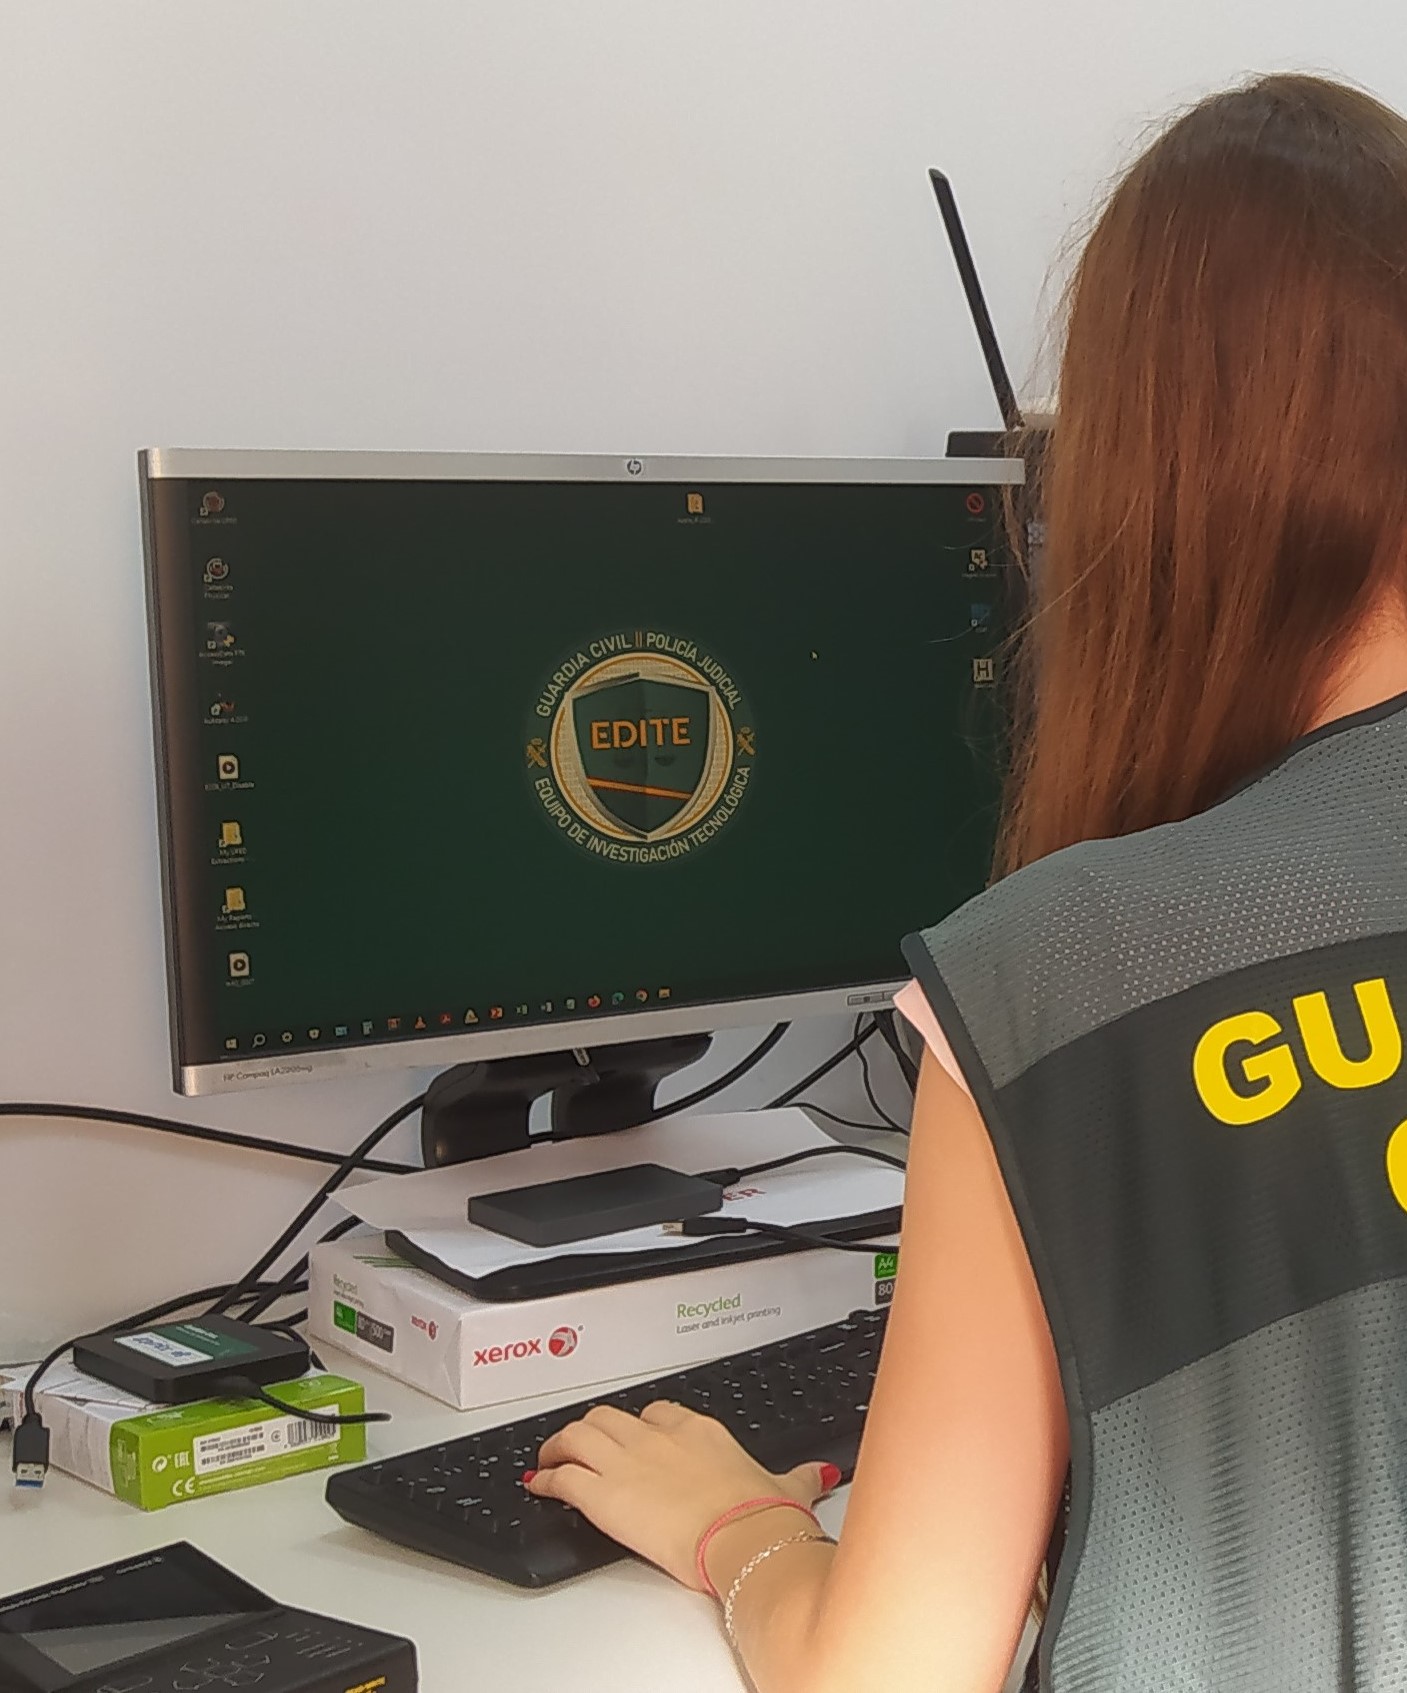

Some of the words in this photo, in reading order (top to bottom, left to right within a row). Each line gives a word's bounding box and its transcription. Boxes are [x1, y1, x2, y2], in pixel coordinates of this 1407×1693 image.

[536, 652, 590, 717] GUARDIA
[589, 633, 632, 658] CIVIL
[646, 632, 698, 662] POLICÍA
[697, 654, 743, 710] JUDICIAL
[591, 717, 691, 750] EDITE
[535, 777, 572, 828] EQUIPO
[567, 821, 590, 845] DE
[587, 836, 690, 863] INVESTIGACIÓN
[688, 766, 751, 846] TECNOLÓGICA
[878, 1282, 893, 1296] 80
[676, 1293, 741, 1318] Recycled
[676, 1322, 700, 1334] Laser
[701, 1318, 719, 1329] and
[747, 1306, 781, 1321] printing
[473, 1338, 541, 1366] xerox
